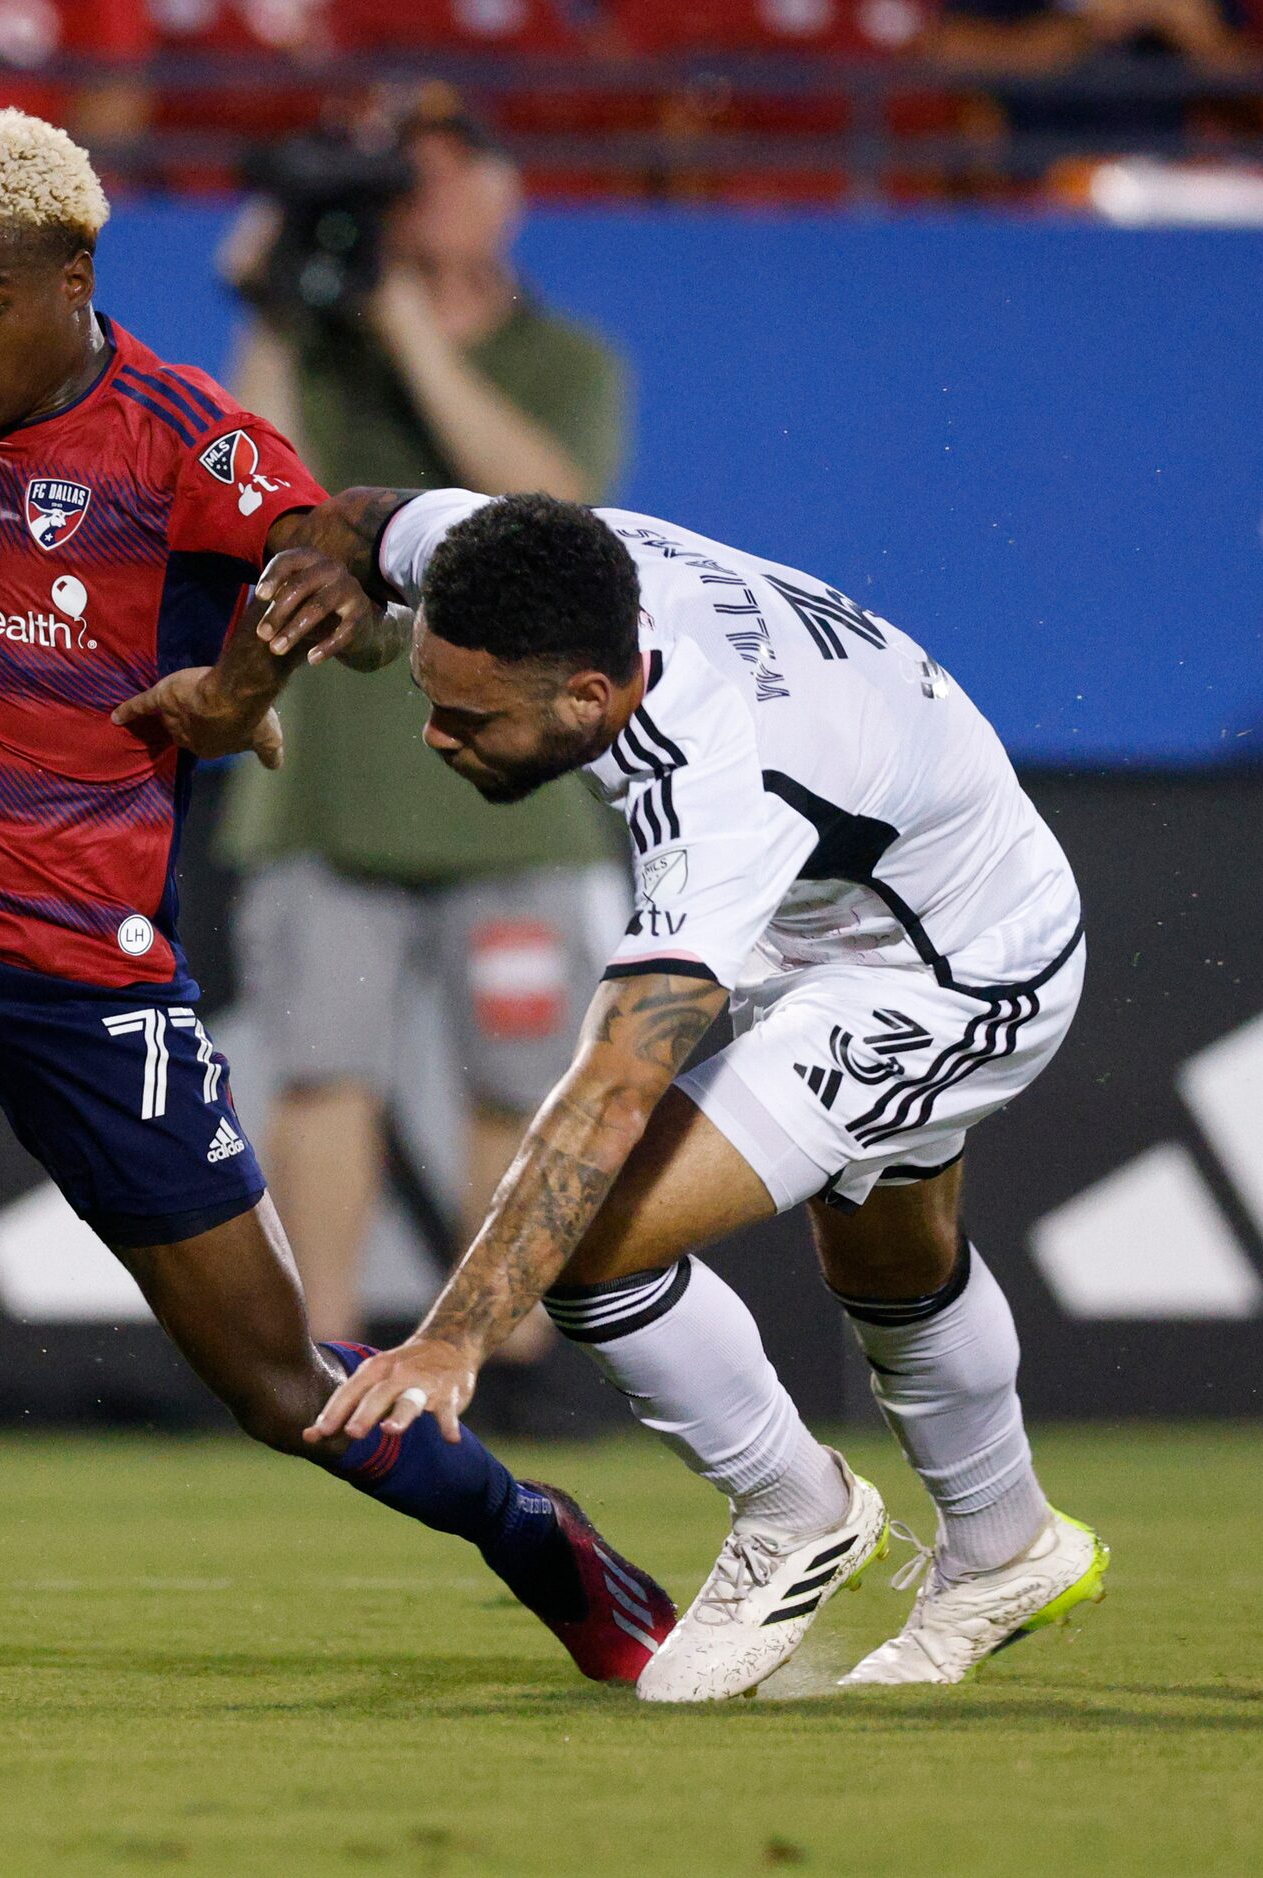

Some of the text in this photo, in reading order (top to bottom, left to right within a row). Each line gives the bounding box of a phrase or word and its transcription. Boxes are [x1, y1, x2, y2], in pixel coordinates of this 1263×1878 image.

[205, 440, 231, 467] MLS
[31, 483, 87, 507] FC DALLAS
[615, 528, 791, 702] WILLIAMS
[648, 903, 687, 937] tv
[125, 928, 145, 943] LH
[101, 1007, 223, 1121] 77
[206, 1139, 245, 1164] adidas
